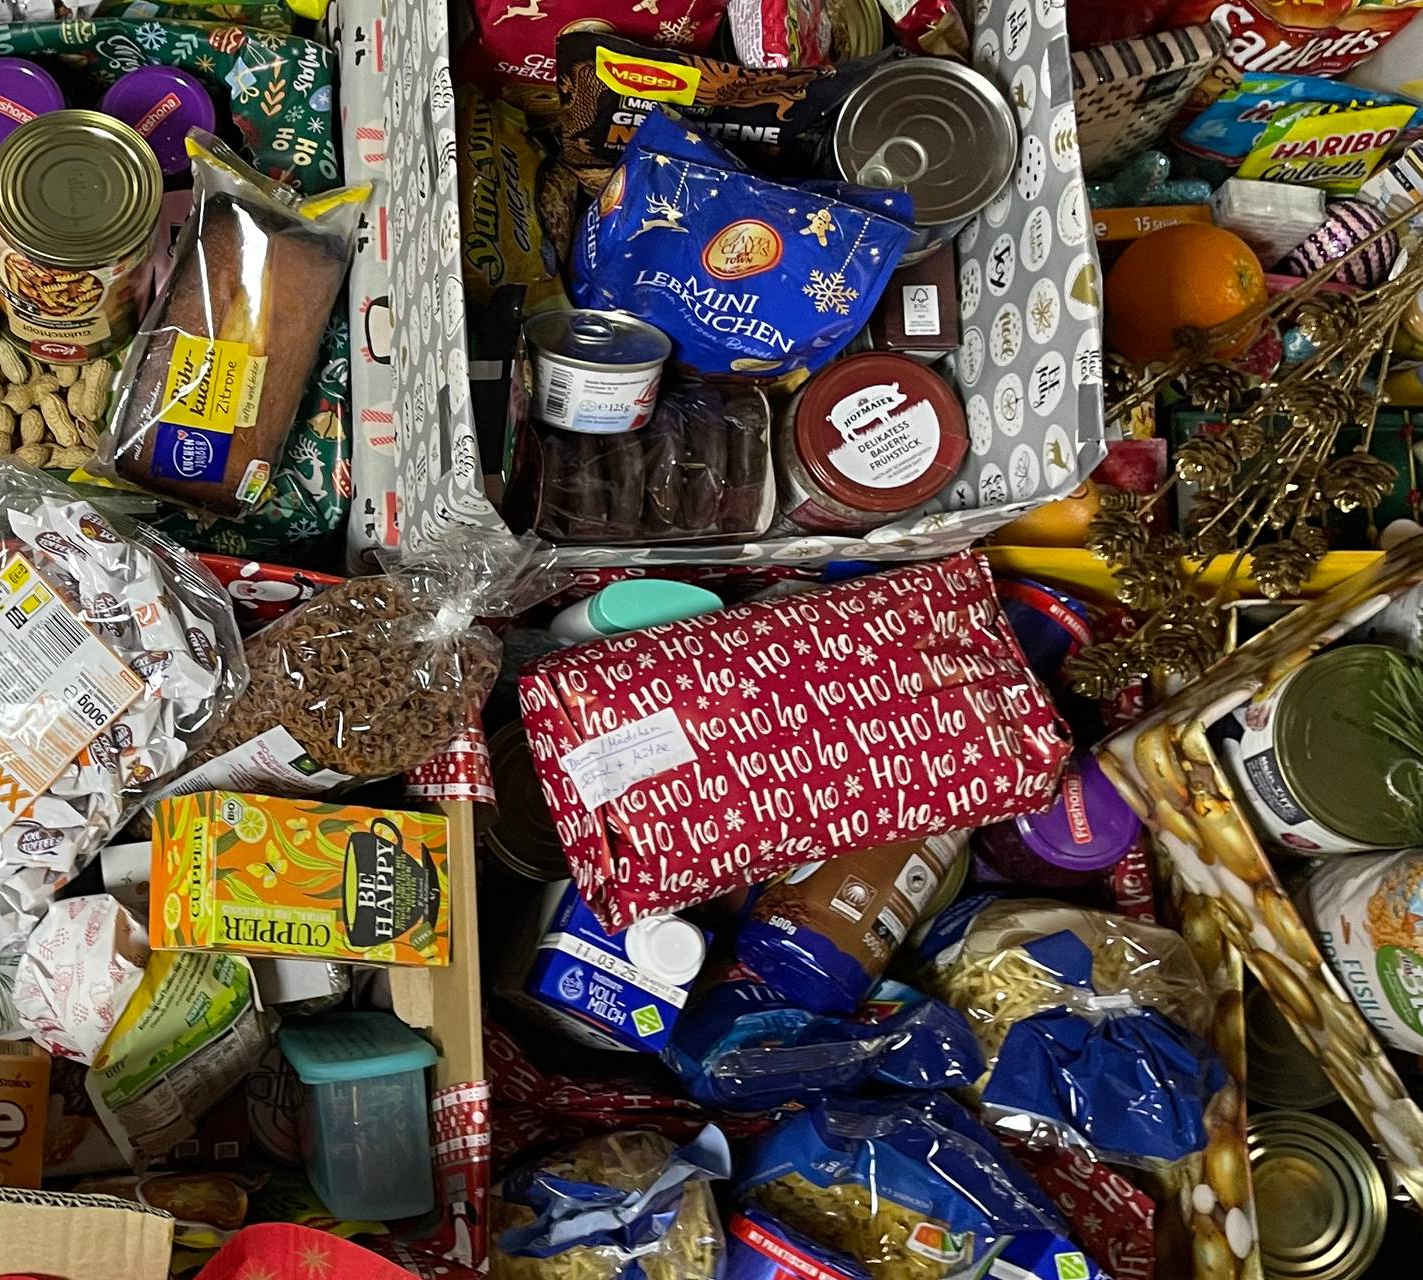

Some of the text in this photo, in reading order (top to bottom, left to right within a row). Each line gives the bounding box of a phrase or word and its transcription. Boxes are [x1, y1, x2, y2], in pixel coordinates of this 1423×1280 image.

[611, 67, 677, 88] Maggi
[138, 98, 176, 136] reshona
[1271, 129, 1401, 160] HARIBO
[1260, 161, 1367, 185] Goliath
[500, 144, 531, 252] CHICKEN
[1134, 216, 1151, 232] 15
[633, 269, 795, 354] LEBKUCHEN
[685, 275, 760, 314] MINI
[216, 361, 237, 414] Zitrone
[843, 396, 895, 428] HOFMAIER
[857, 420, 910, 453] DELIKATESS
[870, 433, 911, 458] BAUERN-
[182, 439, 195, 471] KUCHEN
[195, 440, 208, 469] ZAUBER
[869, 438, 922, 471] FRÜHSTÜCK
[659, 598, 865, 661] HO HO ho
[577, 609, 906, 735] ho ho HO HO
[78, 694, 109, 726] 900g
[686, 658, 924, 751] ho HO ho ho
[649, 779, 692, 816] HO
[726, 749, 767, 788] ho
[812, 728, 849, 769] ho
[846, 717, 887, 755] ho
[931, 695, 966, 737] ho
[228, 803, 236, 821] BIO
[682, 817, 719, 854] ho
[749, 787, 794, 822] HO
[869, 755, 911, 789] HO
[660, 777, 988, 892] ho ho ho HO
[191, 822, 203, 918] CUPPER
[358, 873, 377, 908] BE
[375, 839, 395, 938] HAPPY
[223, 915, 331, 947] CUPPER
[768, 915, 798, 936] 500g
[575, 942, 639, 982] 11.03.25
[588, 982, 626, 1007] VOLL-
[1343, 959, 1393, 1031] FUSILLI
[587, 999, 627, 1026] MILCH
